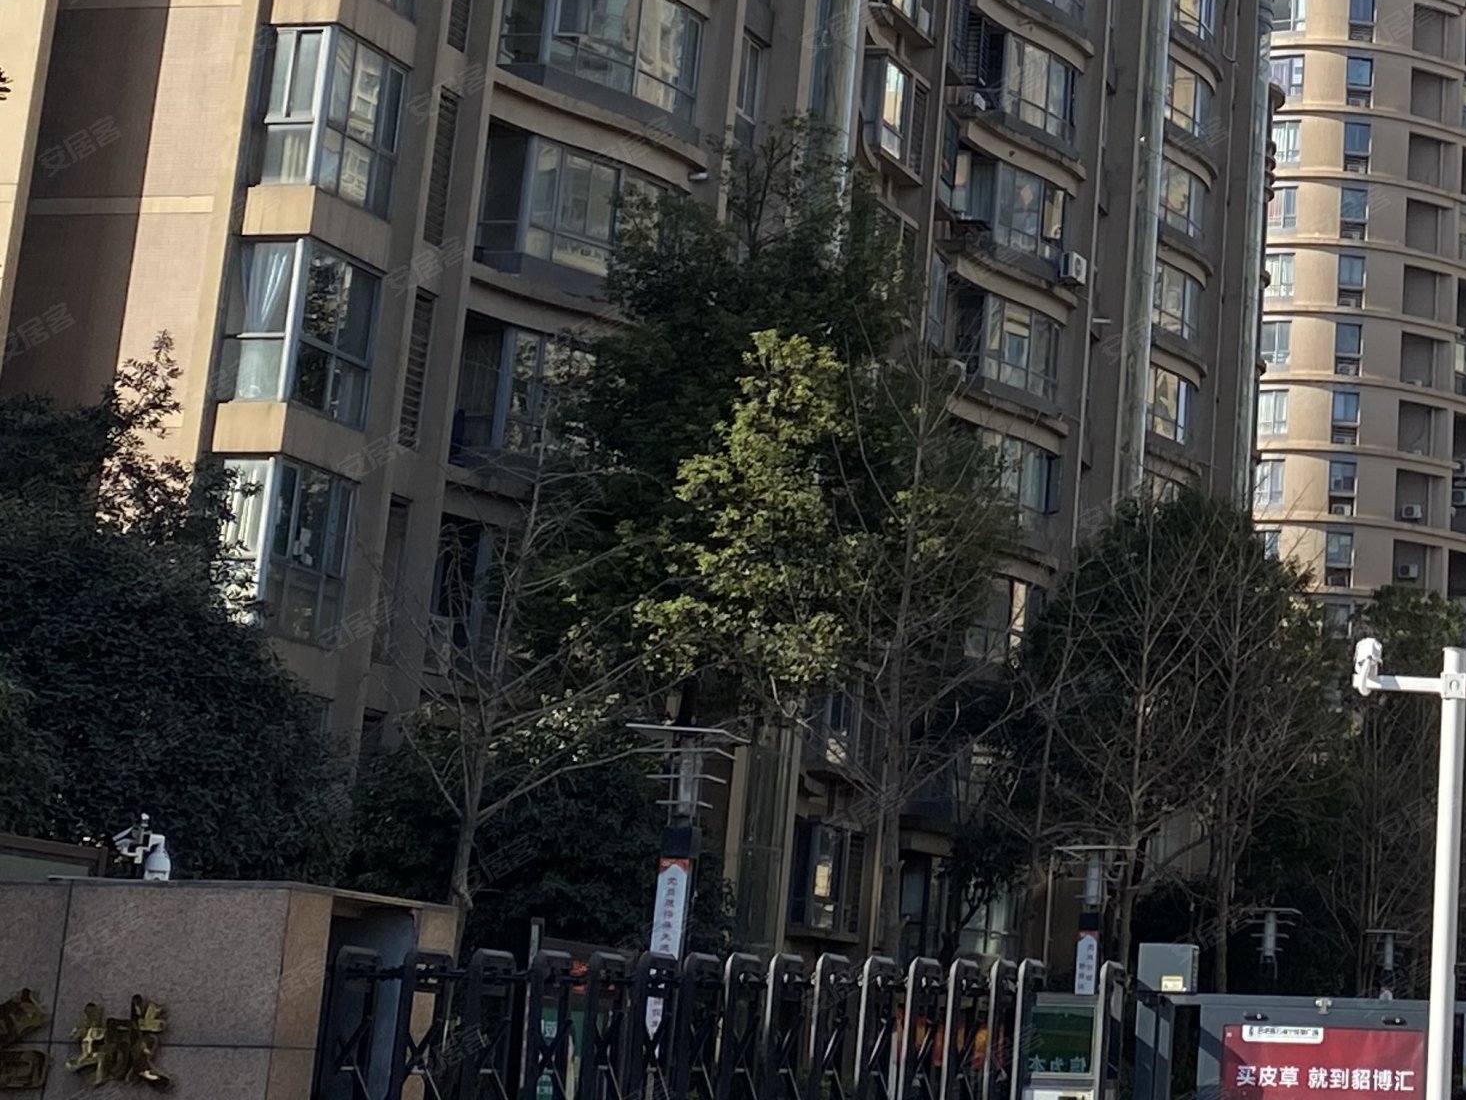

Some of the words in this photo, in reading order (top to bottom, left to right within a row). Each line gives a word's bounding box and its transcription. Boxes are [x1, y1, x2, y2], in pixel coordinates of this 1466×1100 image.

[1236, 1065, 1300, 1088] 买皮草
[1307, 1066, 1415, 1092] 就到貂博汇
